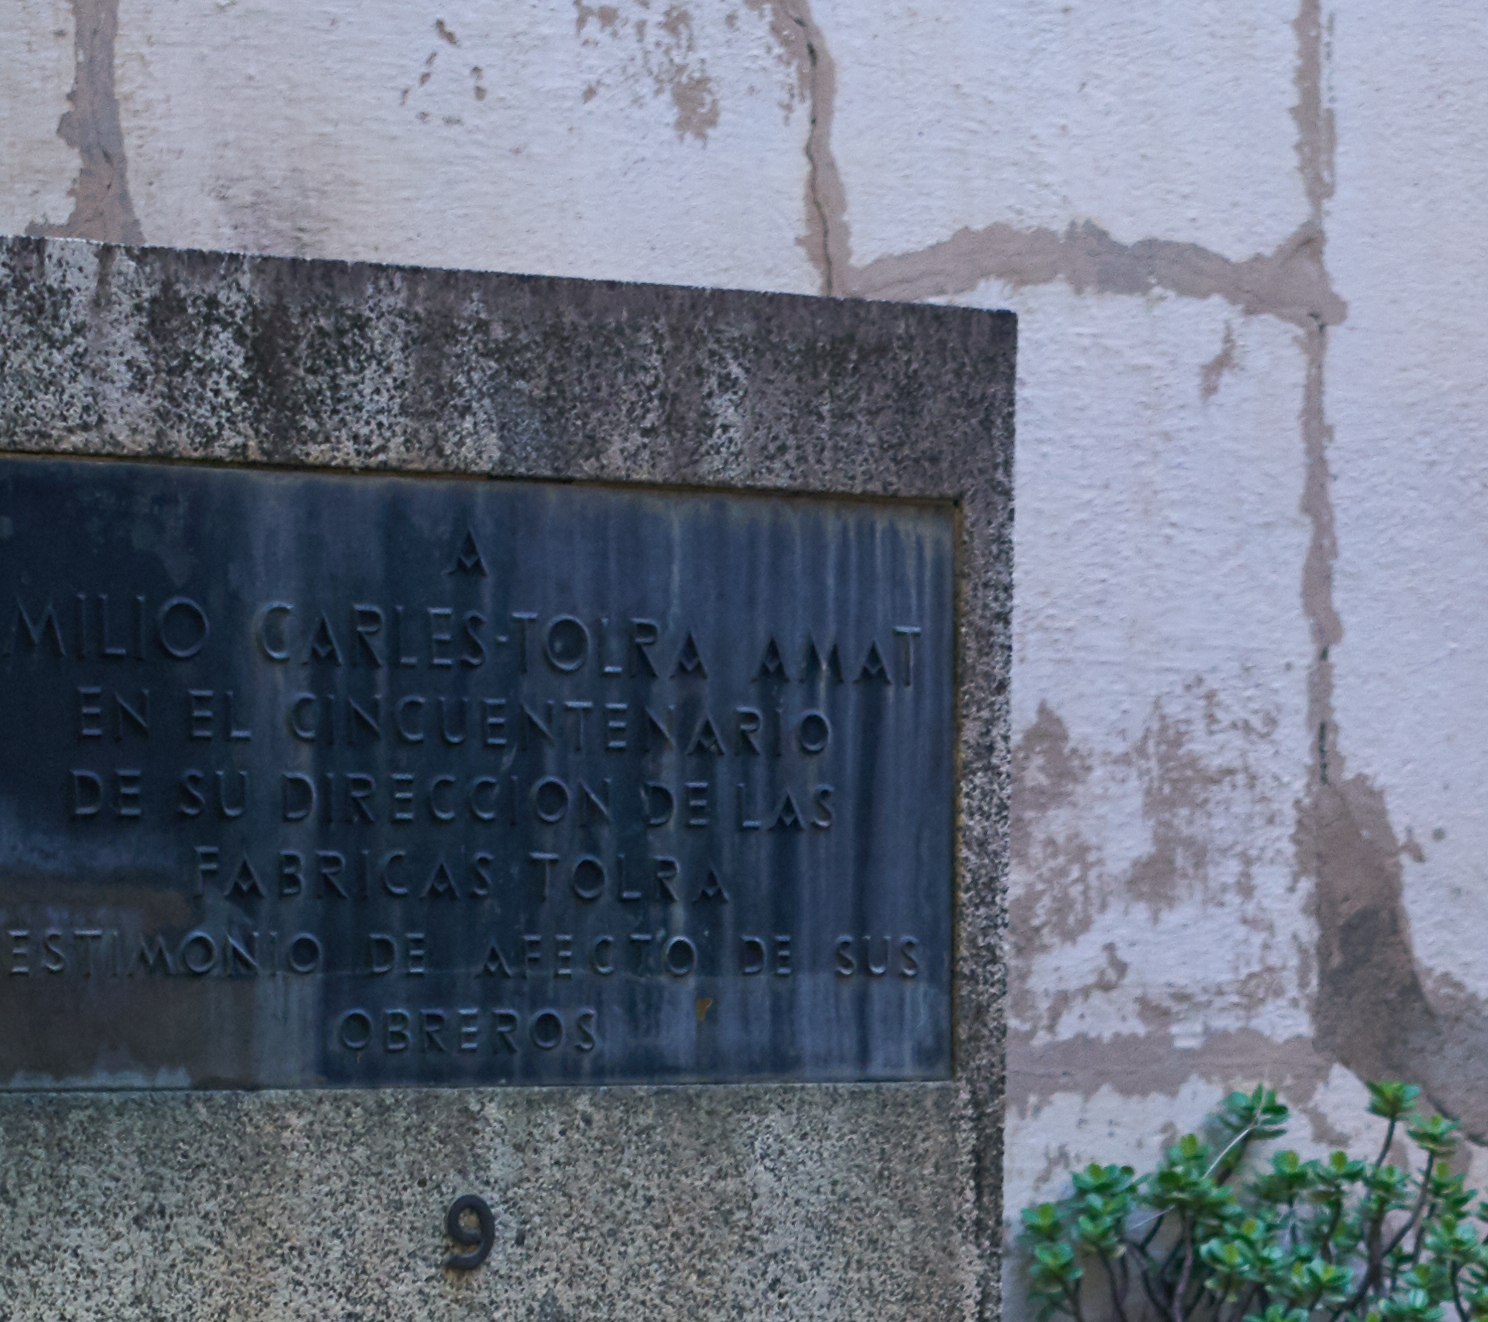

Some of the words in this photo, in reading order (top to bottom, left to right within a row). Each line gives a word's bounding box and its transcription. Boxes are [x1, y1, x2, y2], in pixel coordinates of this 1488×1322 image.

[444, 529, 488, 577] A
[751, 626, 922, 686] AMAT
[77, 686, 150, 741] EN
[188, 689, 252, 741] EL
[288, 691, 832, 756] CINCUENTENARIO
[69, 768, 142, 817] DE
[174, 768, 249, 819] SU
[281, 771, 612, 827] DIRECCION
[640, 781, 710, 828] DE
[736, 782, 836, 831] LAS
[192, 845, 494, 901] FABRICAS
[528, 851, 730, 903] TOLRA
[369, 932, 426, 976] DE
[475, 933, 699, 979] AFECTO
[739, 934, 794, 977] DE
[834, 935, 921, 979] SUS
[339, 1008, 598, 1054] OBREROS
[445, 1194, 496, 1271] 9
